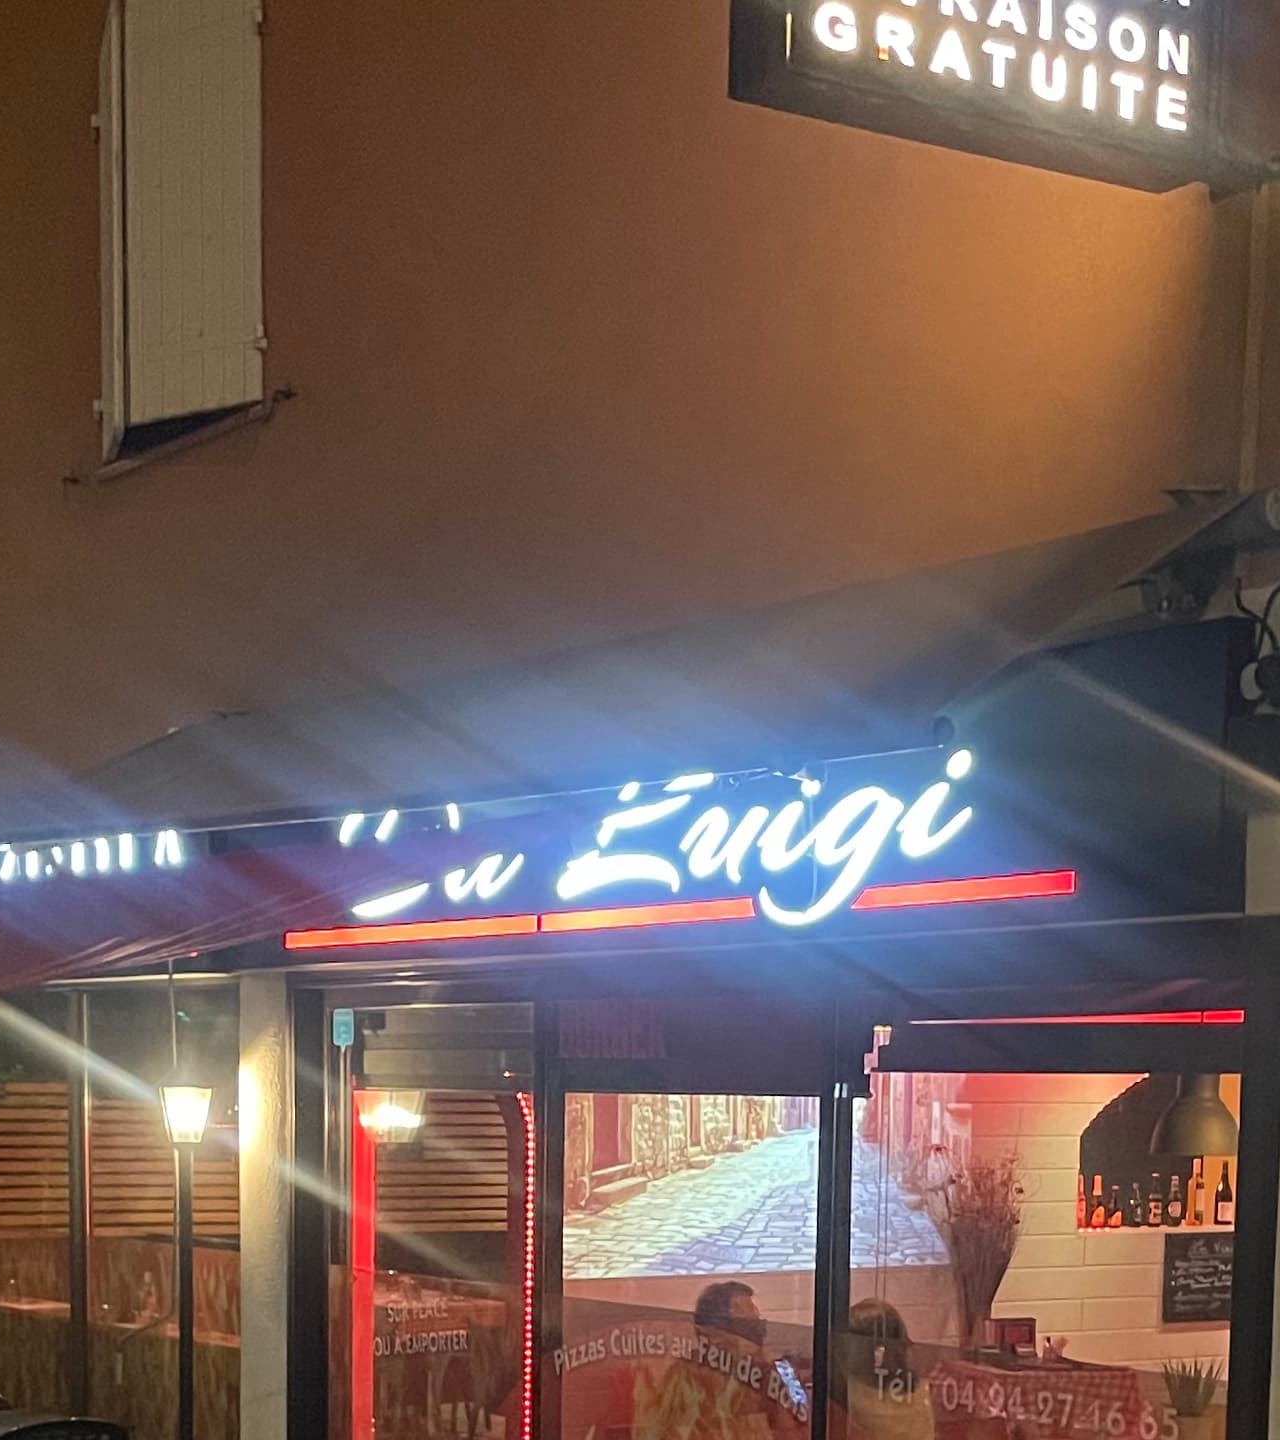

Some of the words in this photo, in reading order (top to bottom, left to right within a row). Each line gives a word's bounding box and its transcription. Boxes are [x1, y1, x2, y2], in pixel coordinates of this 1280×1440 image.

[813, 1, 1189, 132] GRATUITE
[900, 0, 1190, 75] AISON
[557, 749, 973, 926] Luigi
[373, 1336, 391, 1357] OU
[406, 1329, 468, 1353] EMPORTER
[386, 1302, 409, 1322] SUR
[412, 1297, 449, 1319] PLACE
[554, 1338, 607, 1375] Pizzas
[610, 1328, 665, 1356] Cuites
[671, 1334, 693, 1361] au
[697, 1335, 731, 1374] Feu
[736, 1354, 762, 1389] de
[874, 1368, 912, 1404] Tél
[942, 1377, 976, 1413] 04
[988, 1382, 1025, 1420] 94
[1037, 1391, 1073, 1429] 27
[1086, 1400, 1126, 1435] 16
